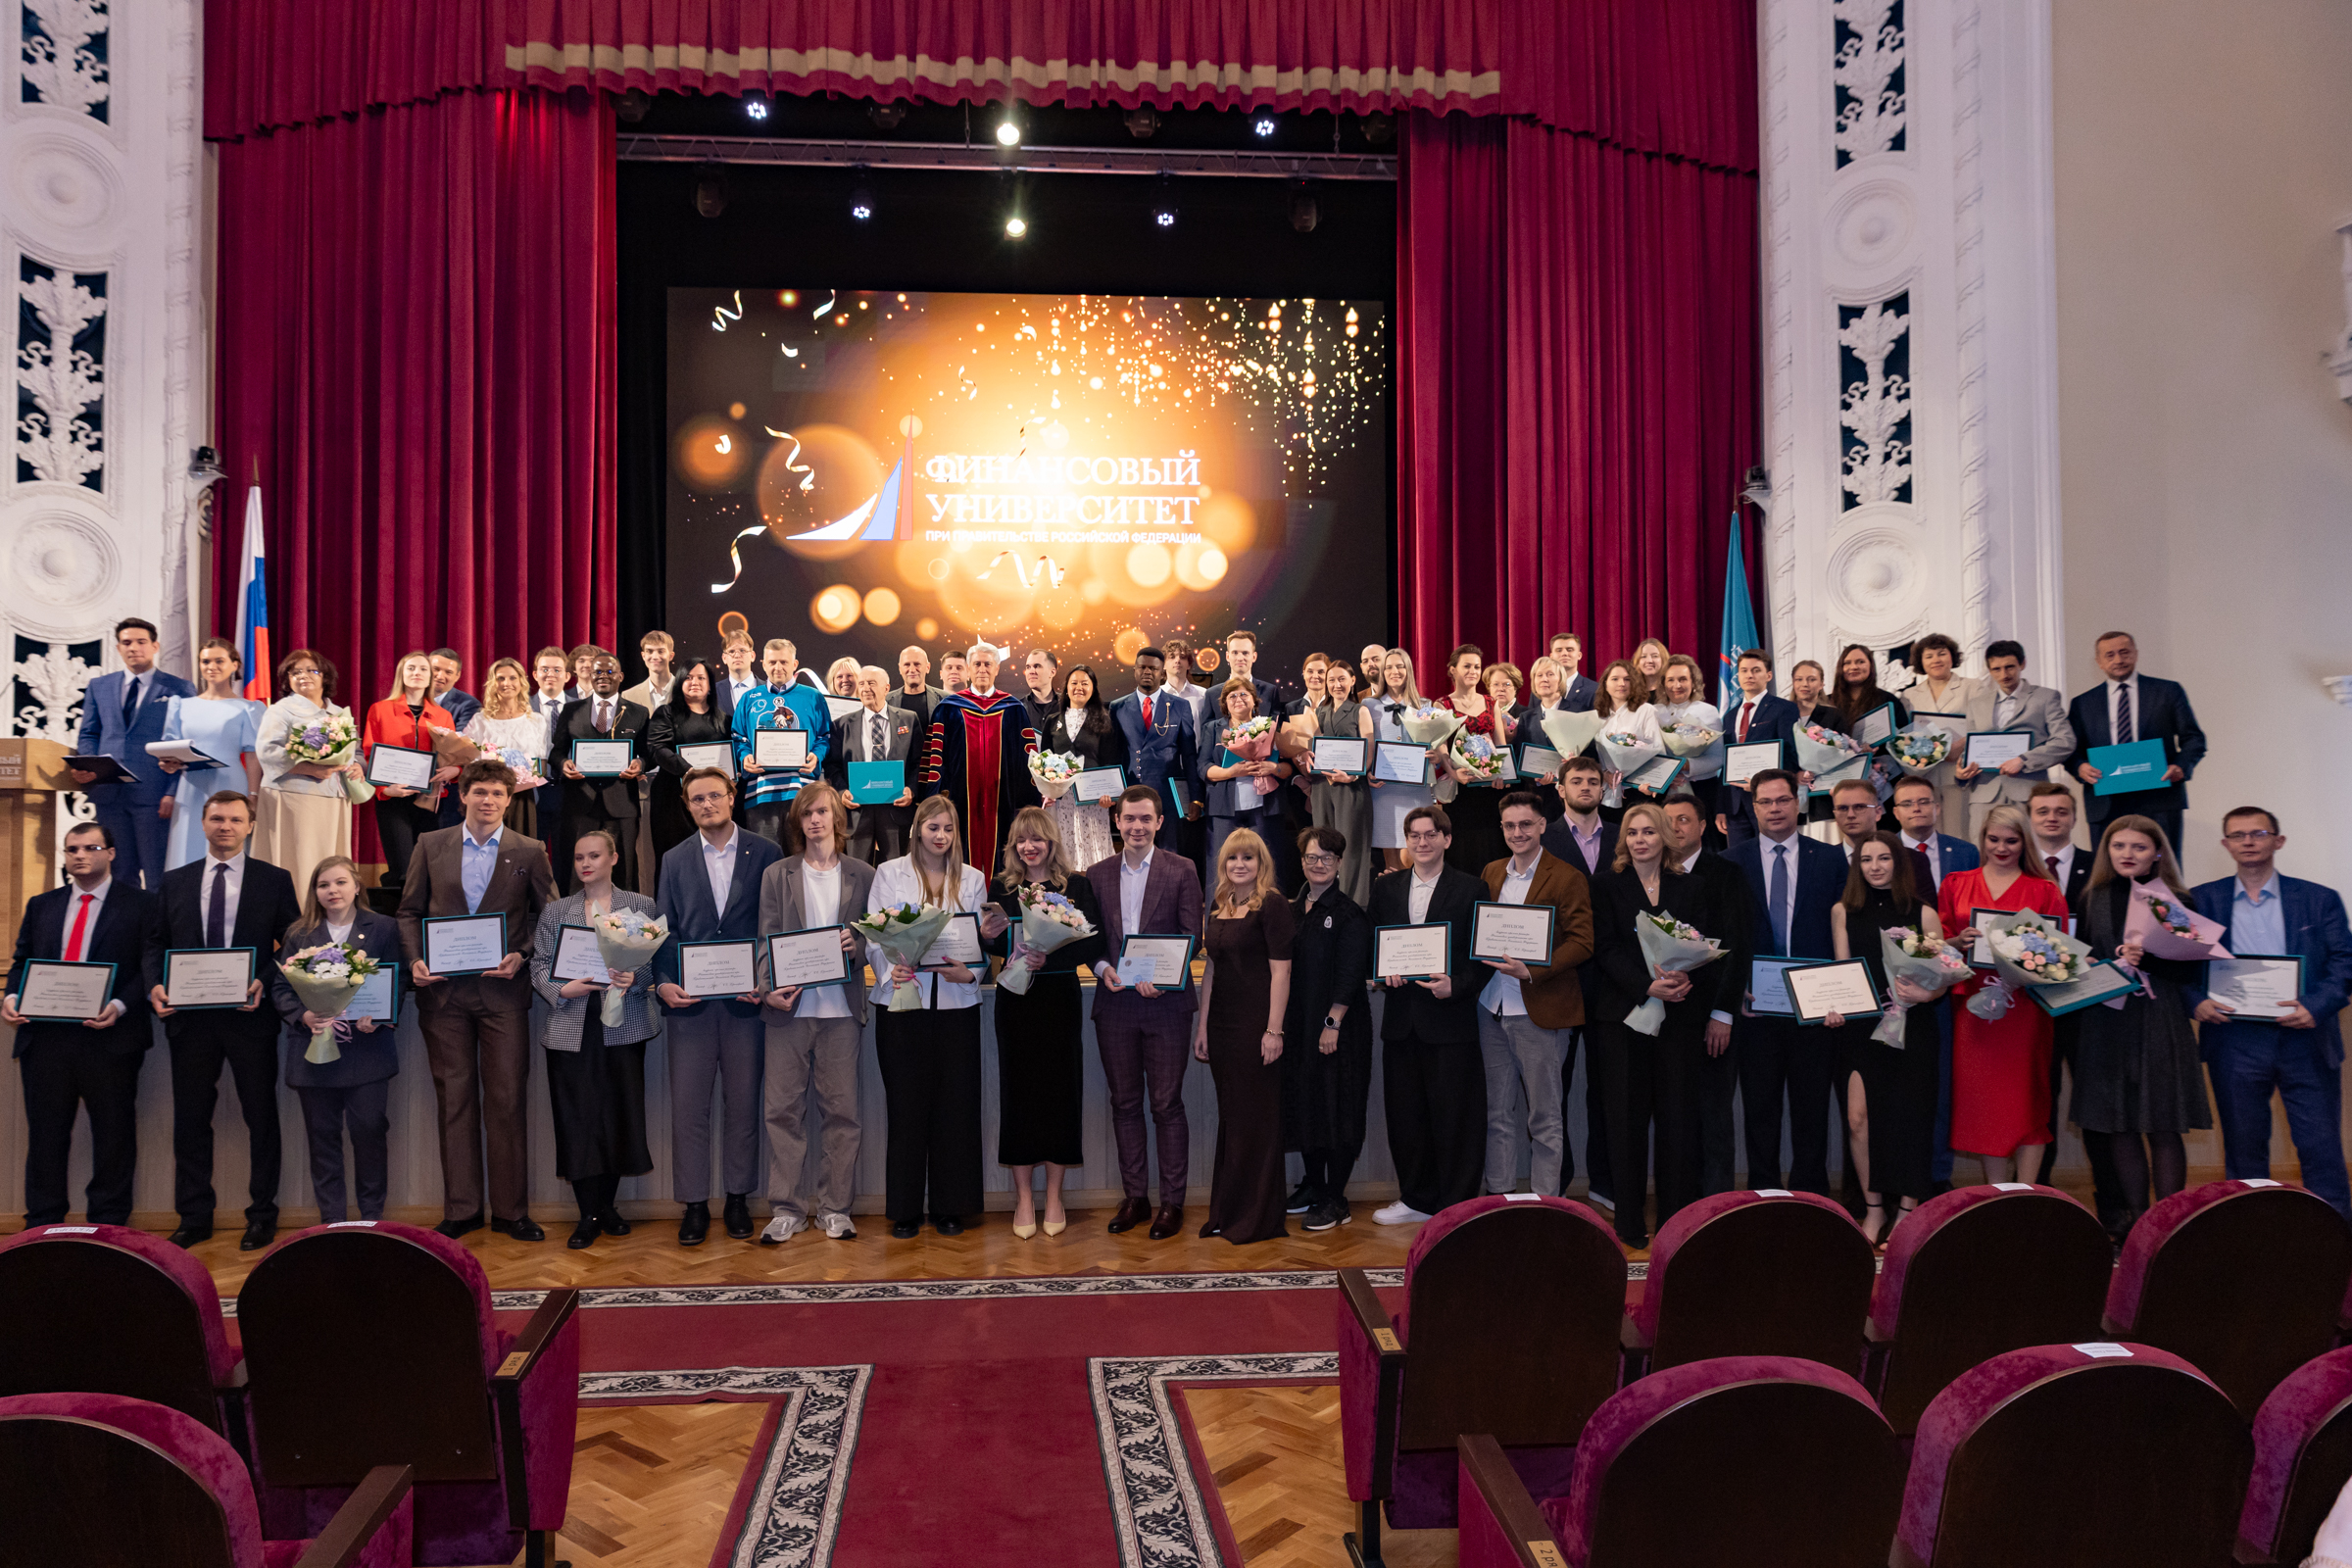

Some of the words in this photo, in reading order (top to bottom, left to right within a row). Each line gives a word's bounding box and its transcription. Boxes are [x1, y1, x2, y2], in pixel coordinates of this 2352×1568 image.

[925, 449, 1201, 486] ФИНАНСОВЫЙ
[925, 493, 1201, 525] УНИВЕРСИТЕТ
[925, 530, 952, 541] ПРИ
[955, 530, 1050, 543] ПРАВИТЕЛЬСТВЕ
[1051, 529, 1130, 544] РОССИЙСКОЙ
[1132, 531, 1201, 545] ФЕДЕРАЦИИ
